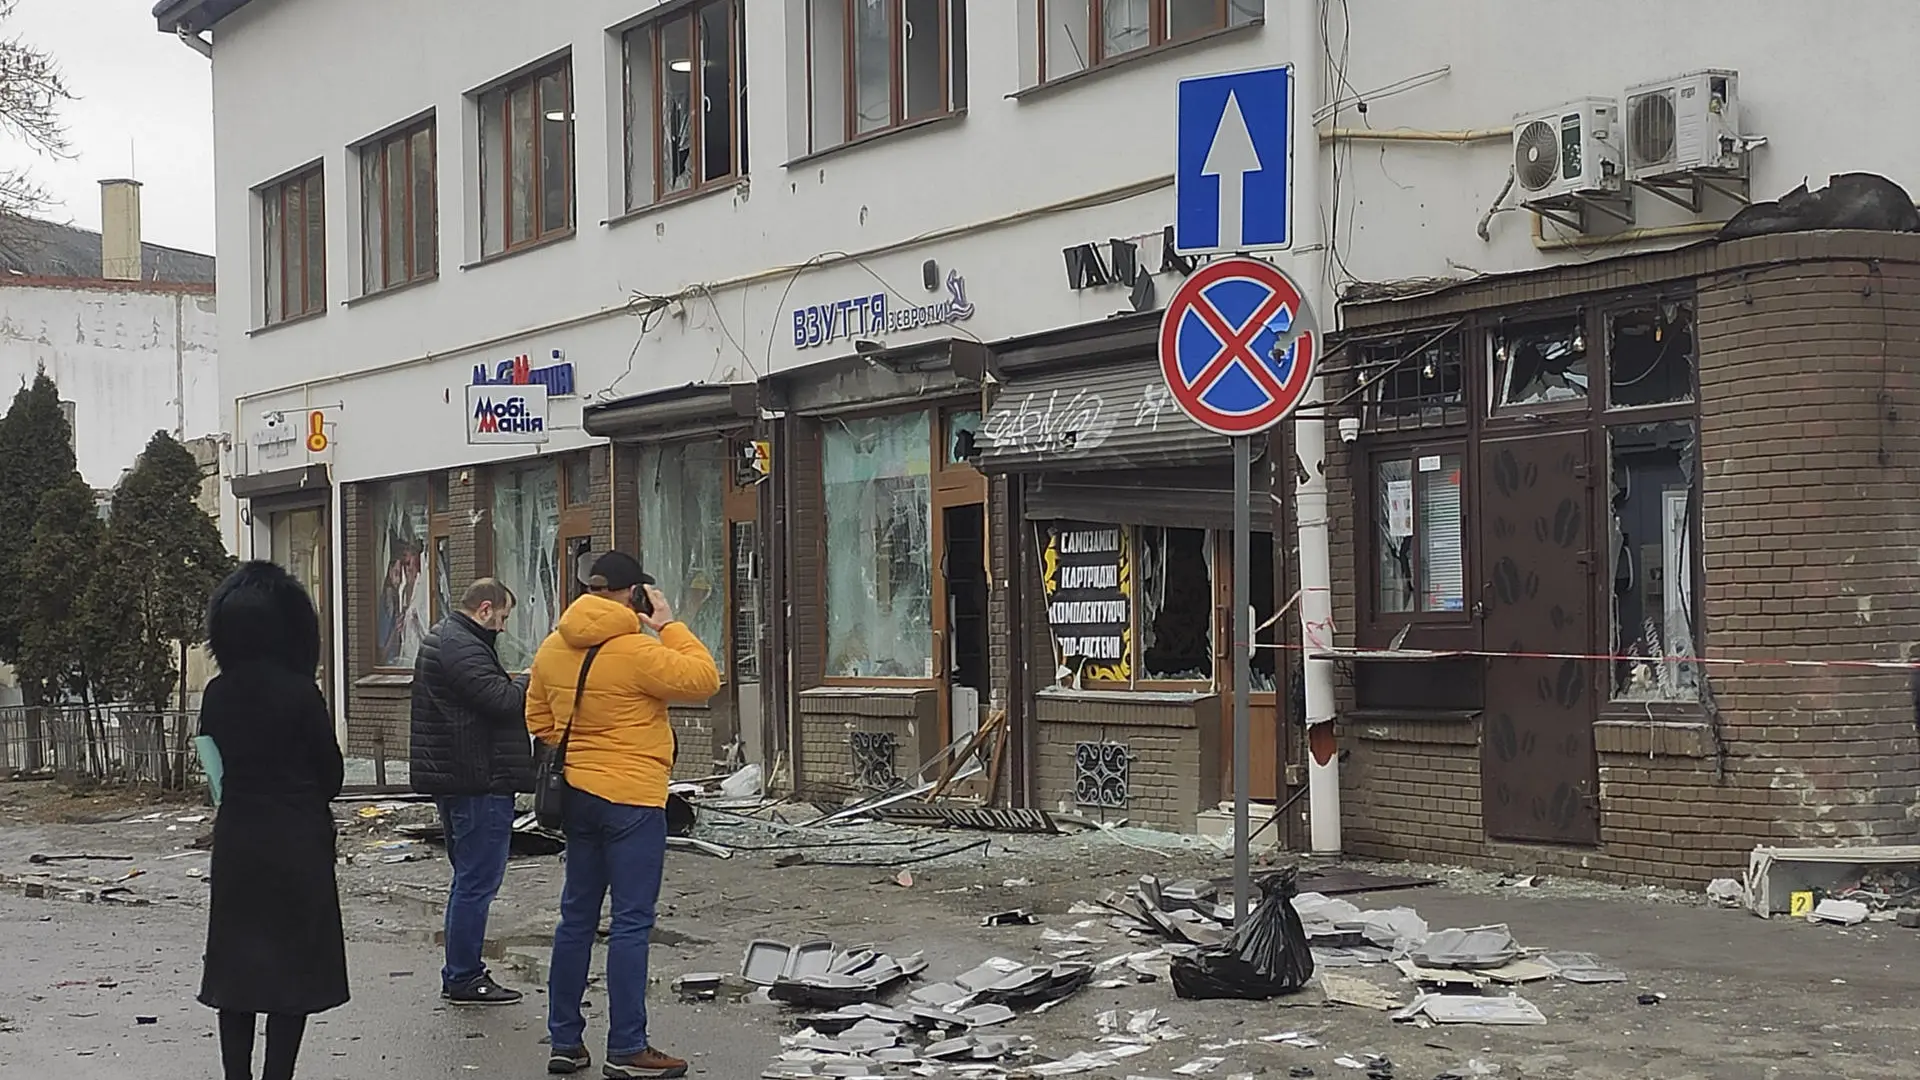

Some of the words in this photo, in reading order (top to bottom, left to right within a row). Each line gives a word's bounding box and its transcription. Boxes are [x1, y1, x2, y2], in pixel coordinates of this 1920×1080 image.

[793, 293, 886, 347] ВЗУТТЯ
[889, 311, 896, 330] З
[896, 305, 946, 328] ЄВРОПИ
[474, 396, 526, 418] Мобі
[478, 412, 543, 433] Манія
[1061, 564, 1118, 589] КАРТРИДЖІ
[1048, 600, 1126, 624] КОМПЛЕКТУЮЧІ
